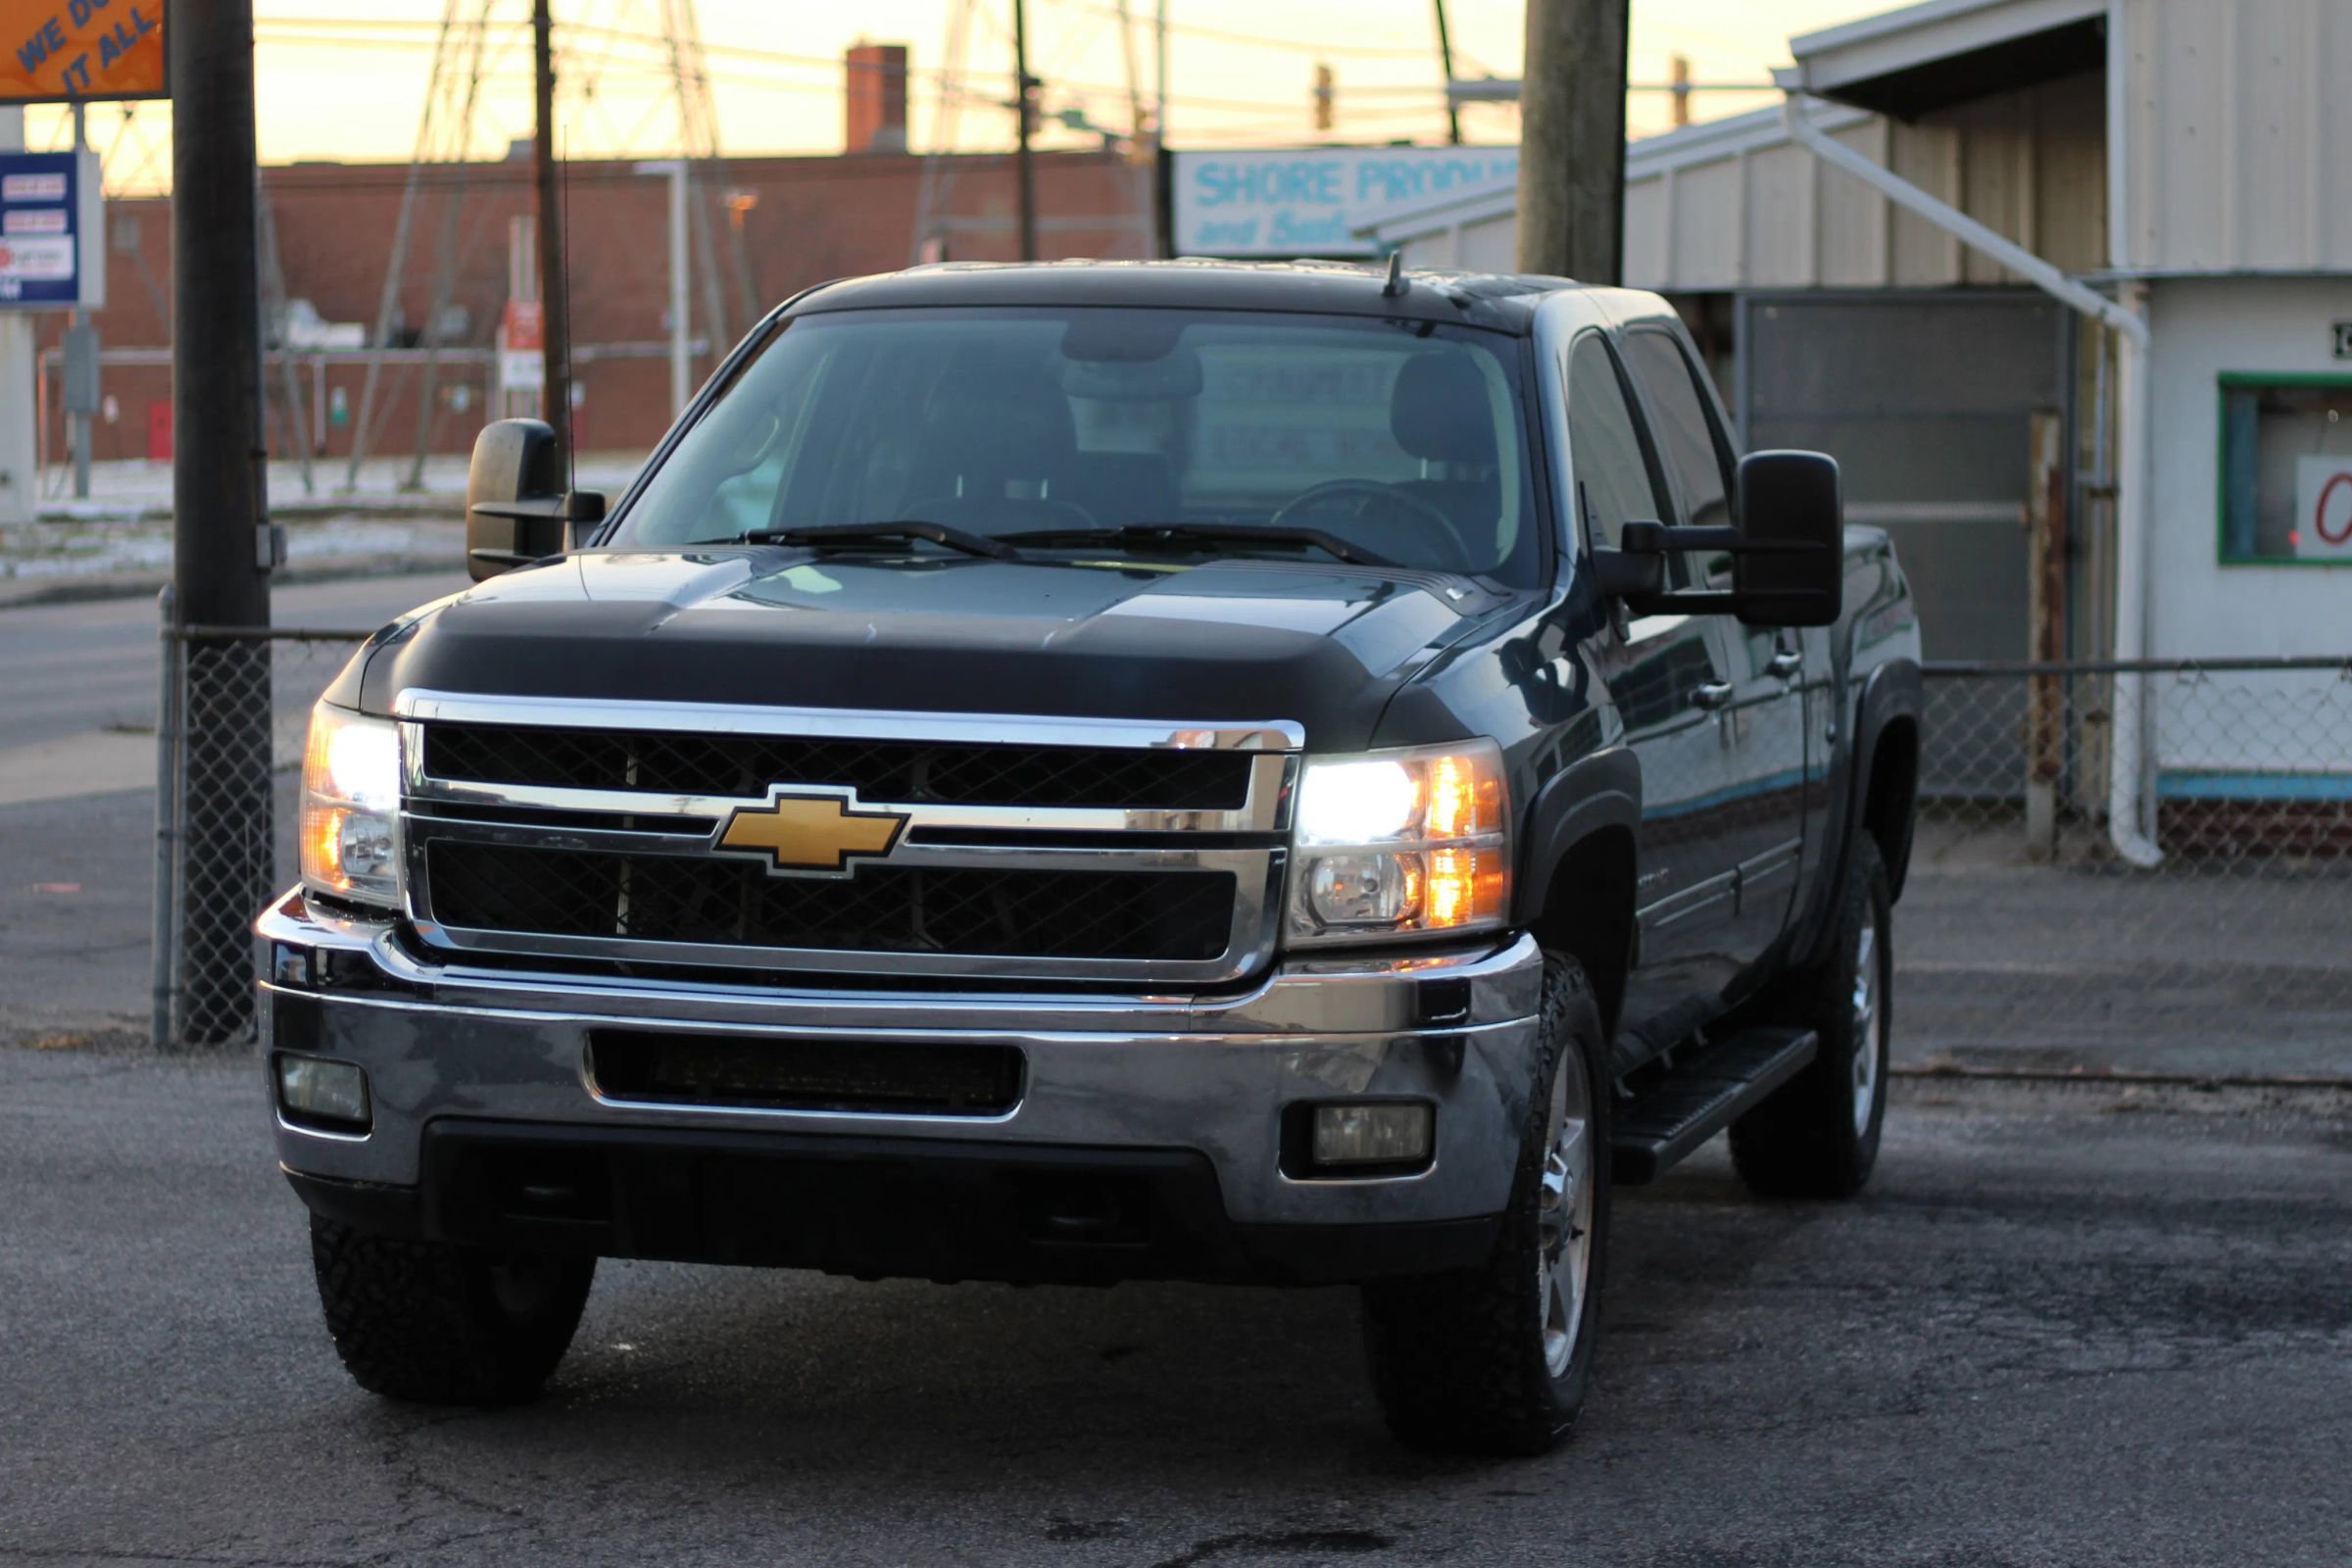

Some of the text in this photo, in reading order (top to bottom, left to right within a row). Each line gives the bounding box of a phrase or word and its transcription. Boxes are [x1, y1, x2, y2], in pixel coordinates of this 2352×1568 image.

[17, 16, 67, 74] WE
[62, 6, 155, 96] IT ALL
[1195, 160, 1344, 206] SHORE
